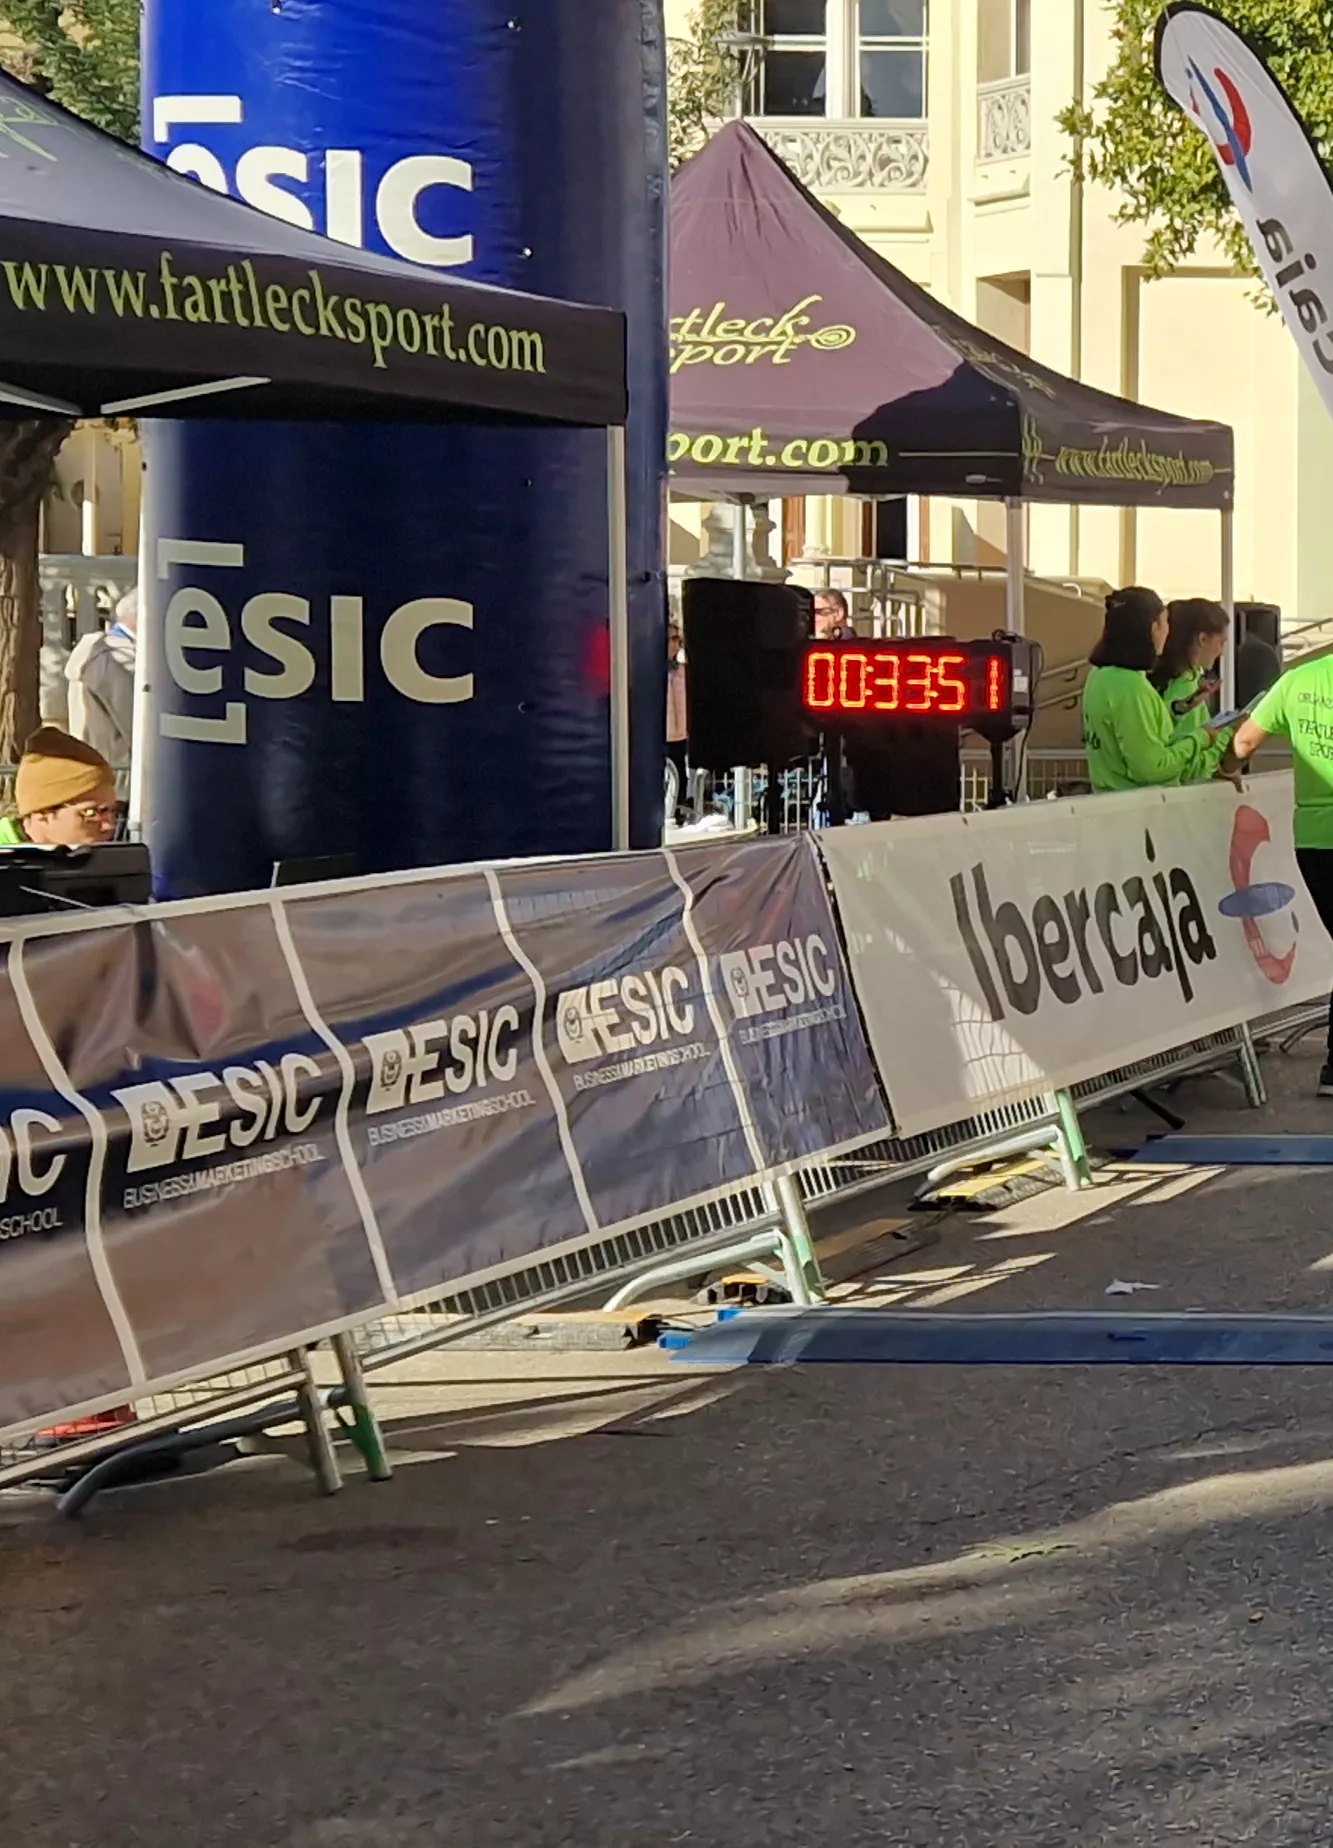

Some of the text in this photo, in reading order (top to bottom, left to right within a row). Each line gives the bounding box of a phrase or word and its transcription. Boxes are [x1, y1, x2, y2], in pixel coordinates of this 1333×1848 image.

[1, 251, 547, 375] www.fartlecksport.com
[669, 336, 798, 374] port
[748, 933, 835, 1015] ESIC
[949, 828, 1217, 1023] Ibercaja
[407, 1004, 520, 1104] ESIC
[589, 966, 695, 1054] ESIC
[168, 1052, 322, 1161] ESIC
